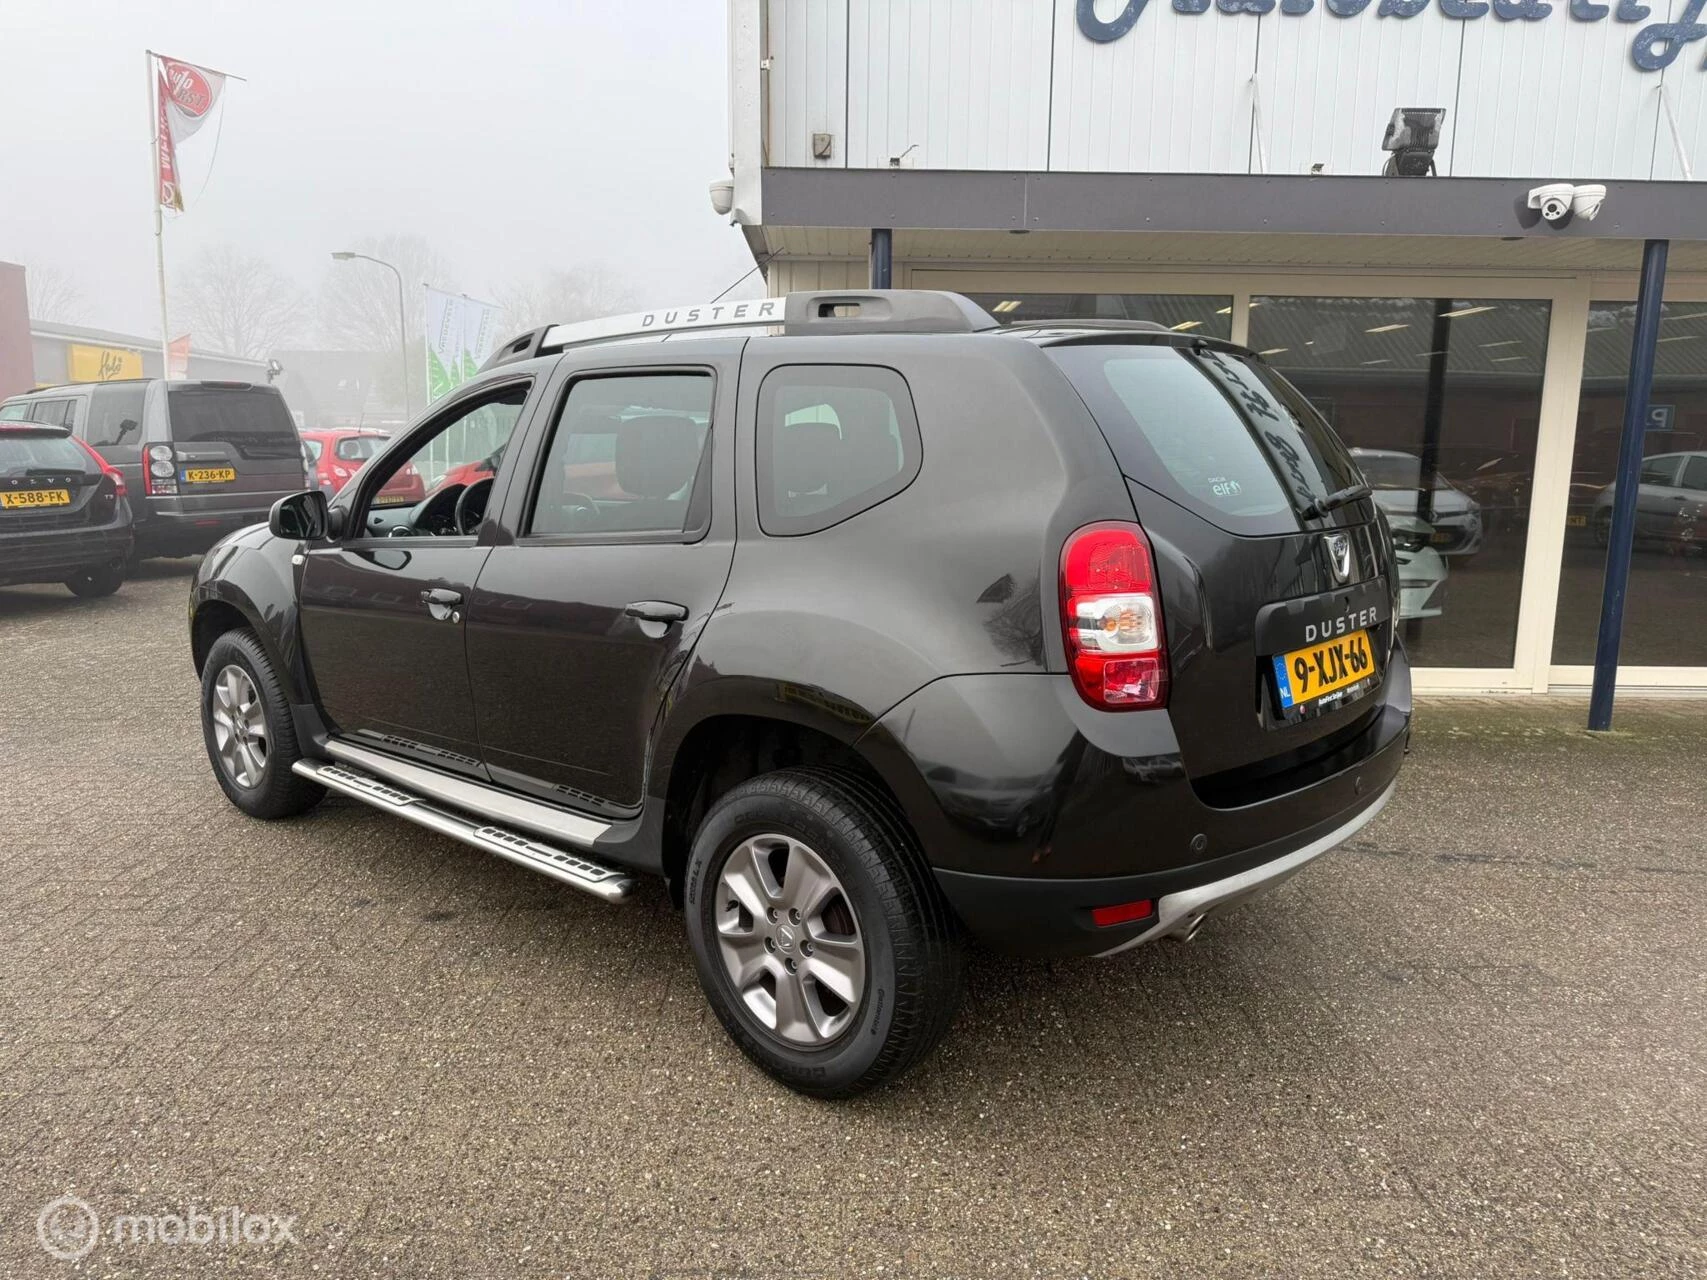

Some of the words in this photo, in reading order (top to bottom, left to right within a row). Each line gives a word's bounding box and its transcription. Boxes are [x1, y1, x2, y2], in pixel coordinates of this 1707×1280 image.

[642, 302, 775, 327] DUSTER
[188, 470, 231, 480] K-236-KP
[5, 491, 65, 505] X-588-FK
[1305, 606, 1377, 642] DUSTER
[1294, 637, 1368, 693] 9-XJX-66
[1280, 687, 1291, 698] NL
